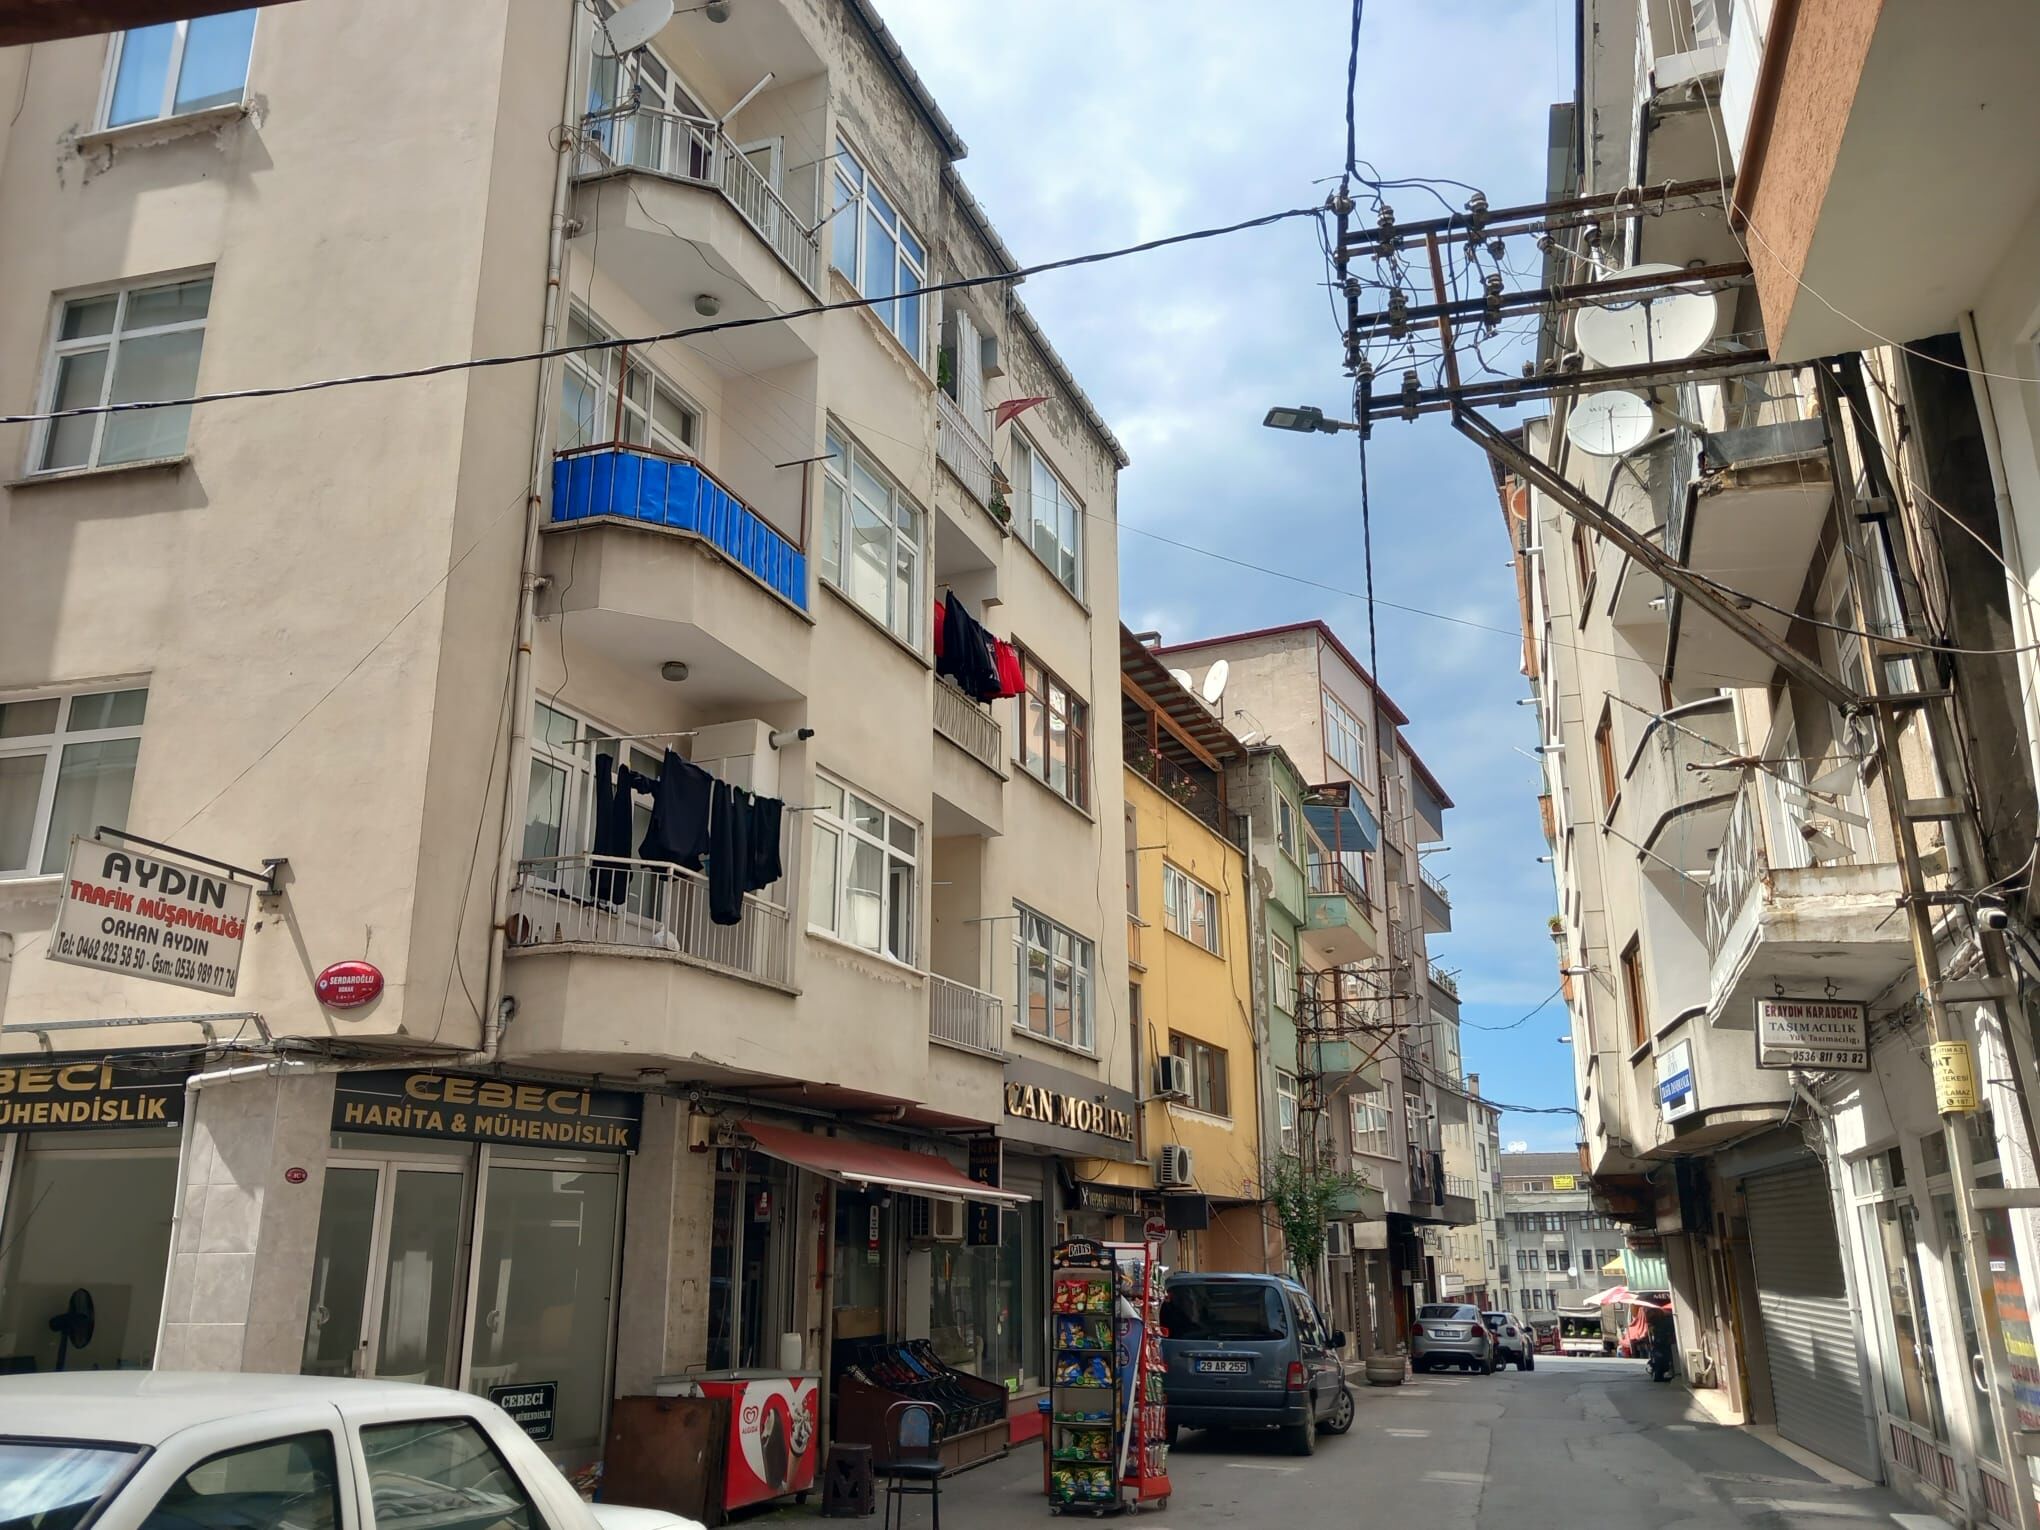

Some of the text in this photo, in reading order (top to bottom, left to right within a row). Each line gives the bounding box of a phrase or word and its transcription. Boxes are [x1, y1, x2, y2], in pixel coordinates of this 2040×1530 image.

[102, 852, 226, 908] AYDIN
[70, 879, 245, 940] TRAFİK MÜŞAVİRLİĞİ
[101, 917, 209, 956] ORHAN AYDIN
[57, 932, 75, 955] Tel:
[76, 935, 101, 960] 0462
[101, 942, 118, 964] 223
[119, 945, 132, 967] 58
[133, 949, 145, 970] 50
[152, 952, 174, 976] Gsm:
[175, 957, 196, 980] 0536
[197, 963, 212, 984] 989
[213, 966, 226, 988] 97
[225, 969, 236, 989] 76
[1793, 1050, 1863, 1064] 0536 811 93 82
[405, 1074, 591, 1116] CEBECİ
[344, 1103, 629, 1147] HARİTA & MÜHENDİSLİK
[1201, 1362, 1246, 1371] 29 AR 255
[501, 1389, 544, 1408] CEBECİ
